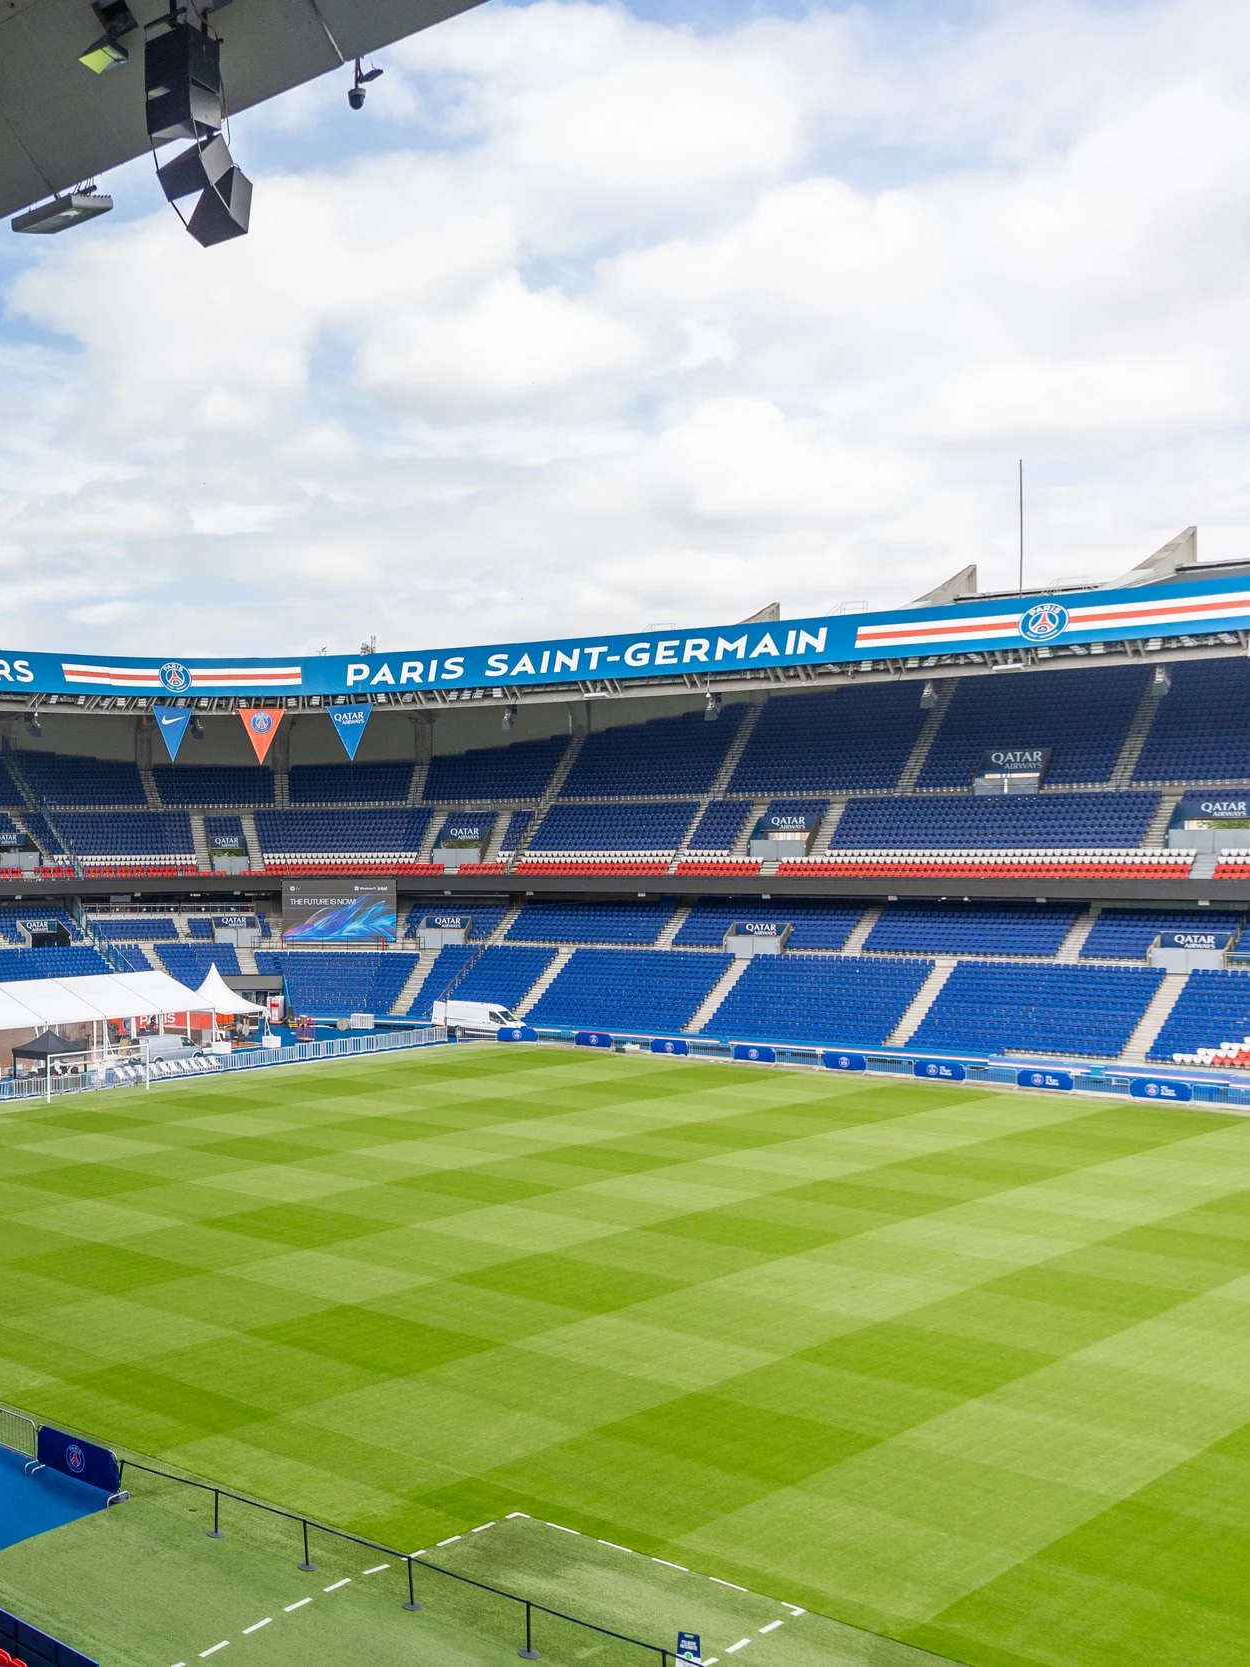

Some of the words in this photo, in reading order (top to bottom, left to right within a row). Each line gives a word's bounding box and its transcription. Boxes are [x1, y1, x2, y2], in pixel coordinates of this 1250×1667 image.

[1028, 604, 1061, 616] PARIS
[346, 657, 464, 686] PARIS
[484, 627, 827, 677] SAINT-GERMAIN
[334, 712, 364, 723] QATAR
[991, 751, 1042, 765] QATAR
[1004, 762, 1042, 770] AIRWAYS
[1201, 802, 1246, 813] QATAR
[771, 817, 805, 827] QATAR
[450, 828, 479, 838] QATAR
[215, 838, 238, 846] QATAR
[290, 898, 303, 906] THE
[303, 898, 330, 906] FUTURE
[222, 916, 246, 925] QATAR
[435, 917, 461, 926] QATAR
[26, 921, 48, 931] QATAR
[746, 923, 776, 933] QATAR
[1174, 934, 1215, 945] QATAR
